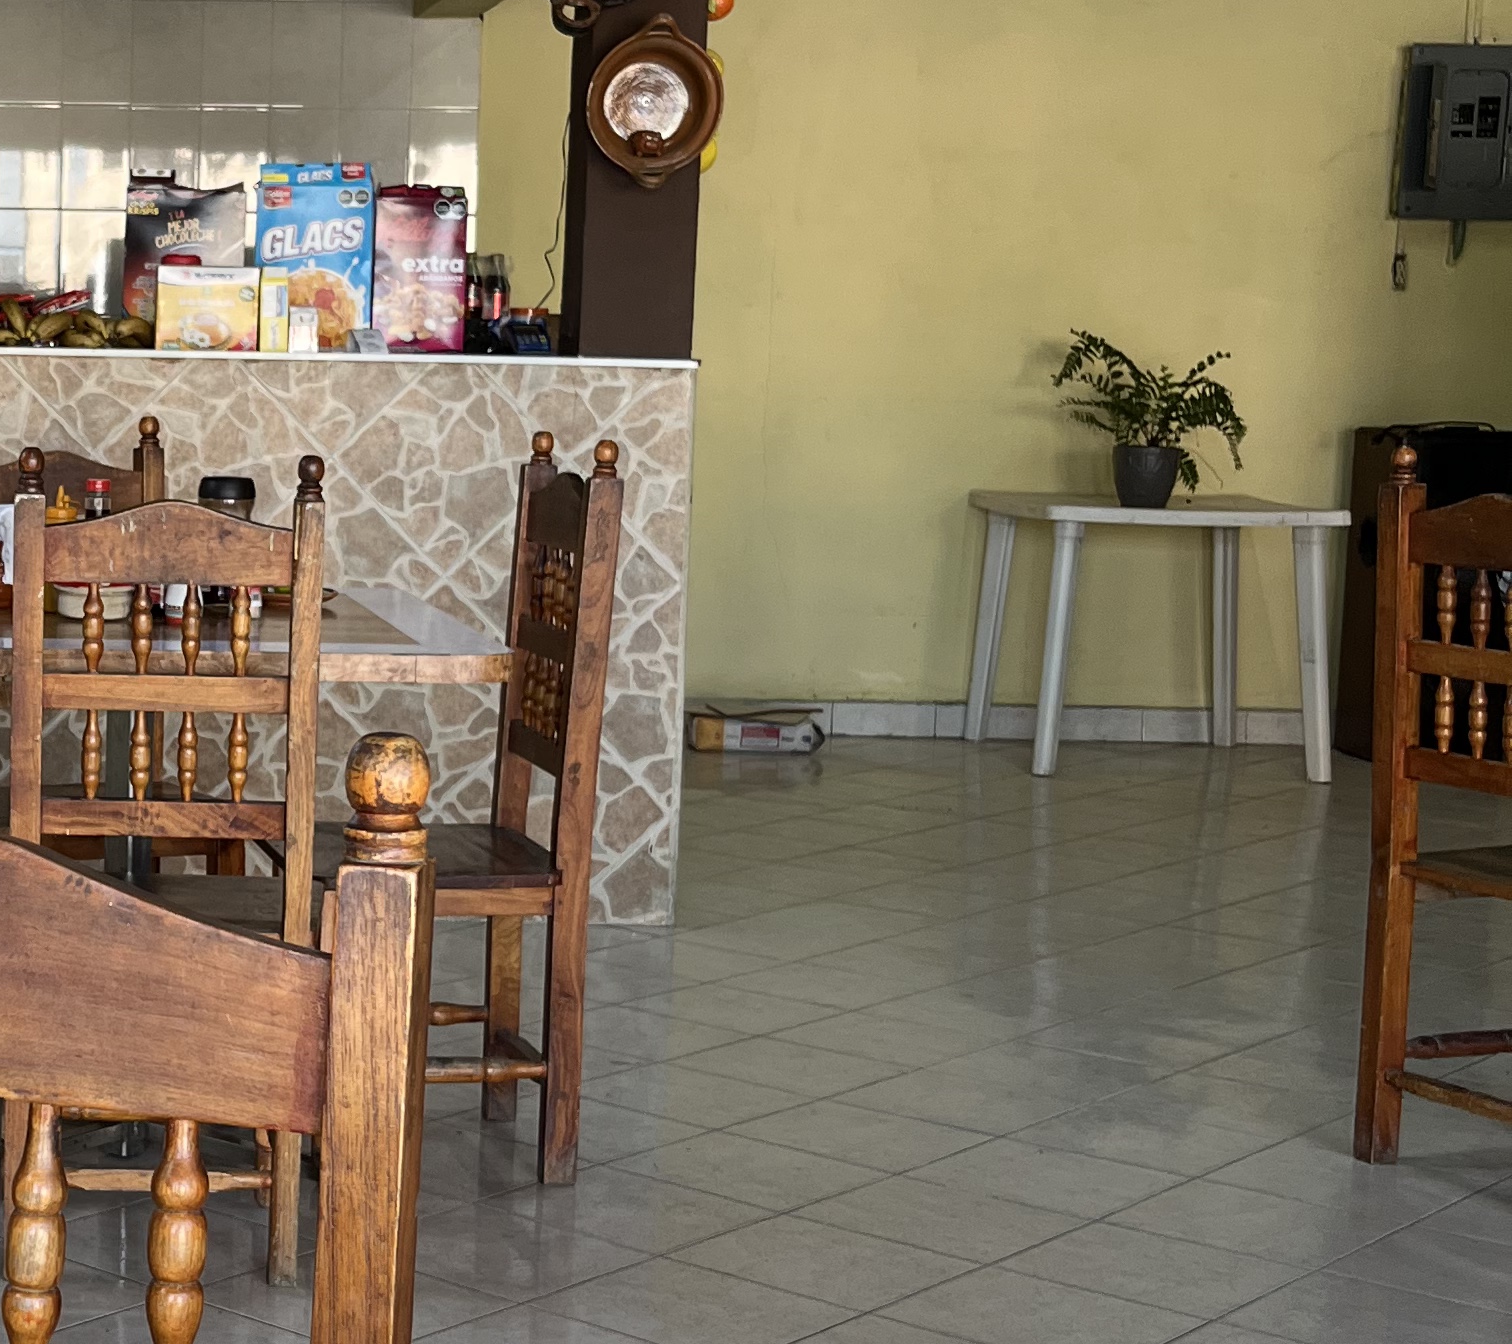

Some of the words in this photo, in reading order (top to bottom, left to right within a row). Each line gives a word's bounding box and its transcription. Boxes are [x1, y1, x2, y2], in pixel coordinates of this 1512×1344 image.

[297, 170, 333, 183] GLACS
[167, 217, 200, 233] MEJOR
[260, 216, 365, 264] GLACS
[401, 255, 464, 274] extra
